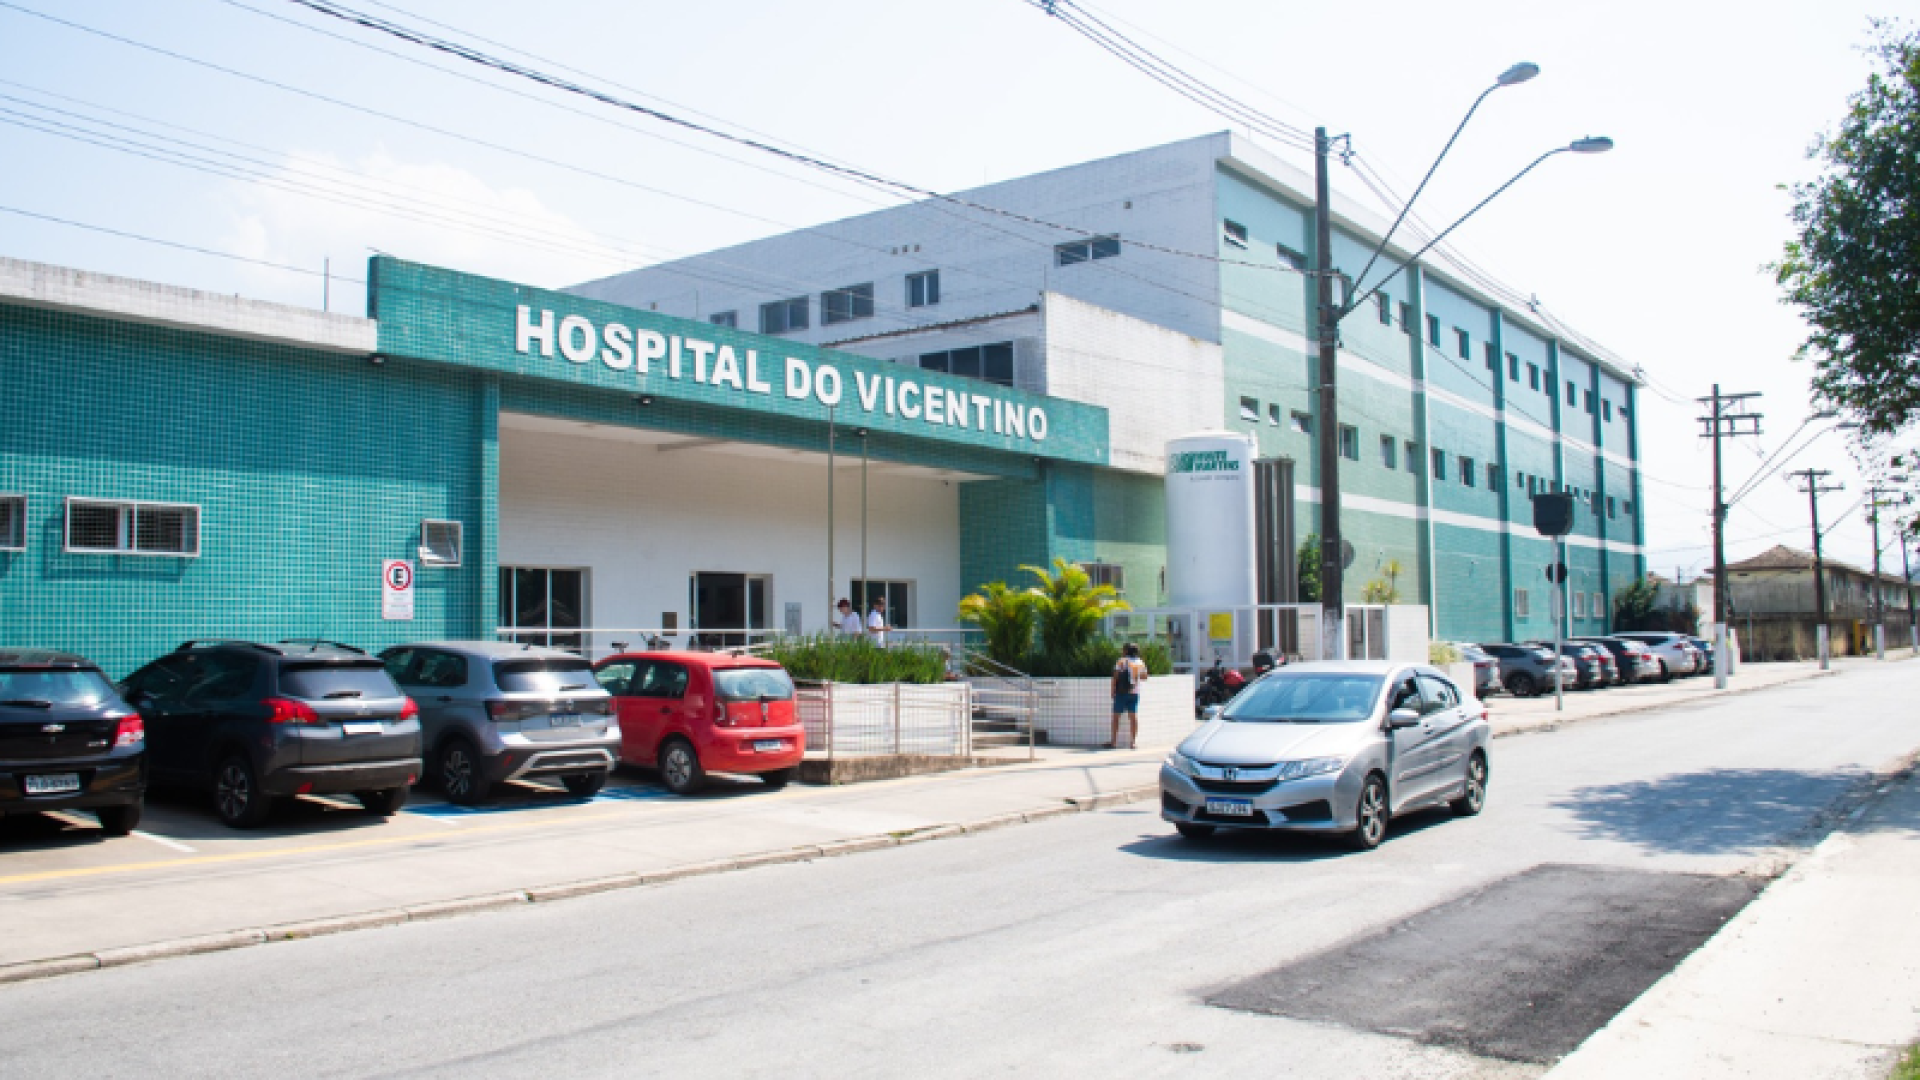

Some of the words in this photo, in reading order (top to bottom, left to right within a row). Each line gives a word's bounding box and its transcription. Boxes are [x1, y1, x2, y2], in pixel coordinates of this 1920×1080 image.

[515, 304, 771, 395] HOSPITAL
[784, 357, 842, 406] DO
[854, 371, 1048, 440] VICENTINO
[393, 568, 404, 586] E
